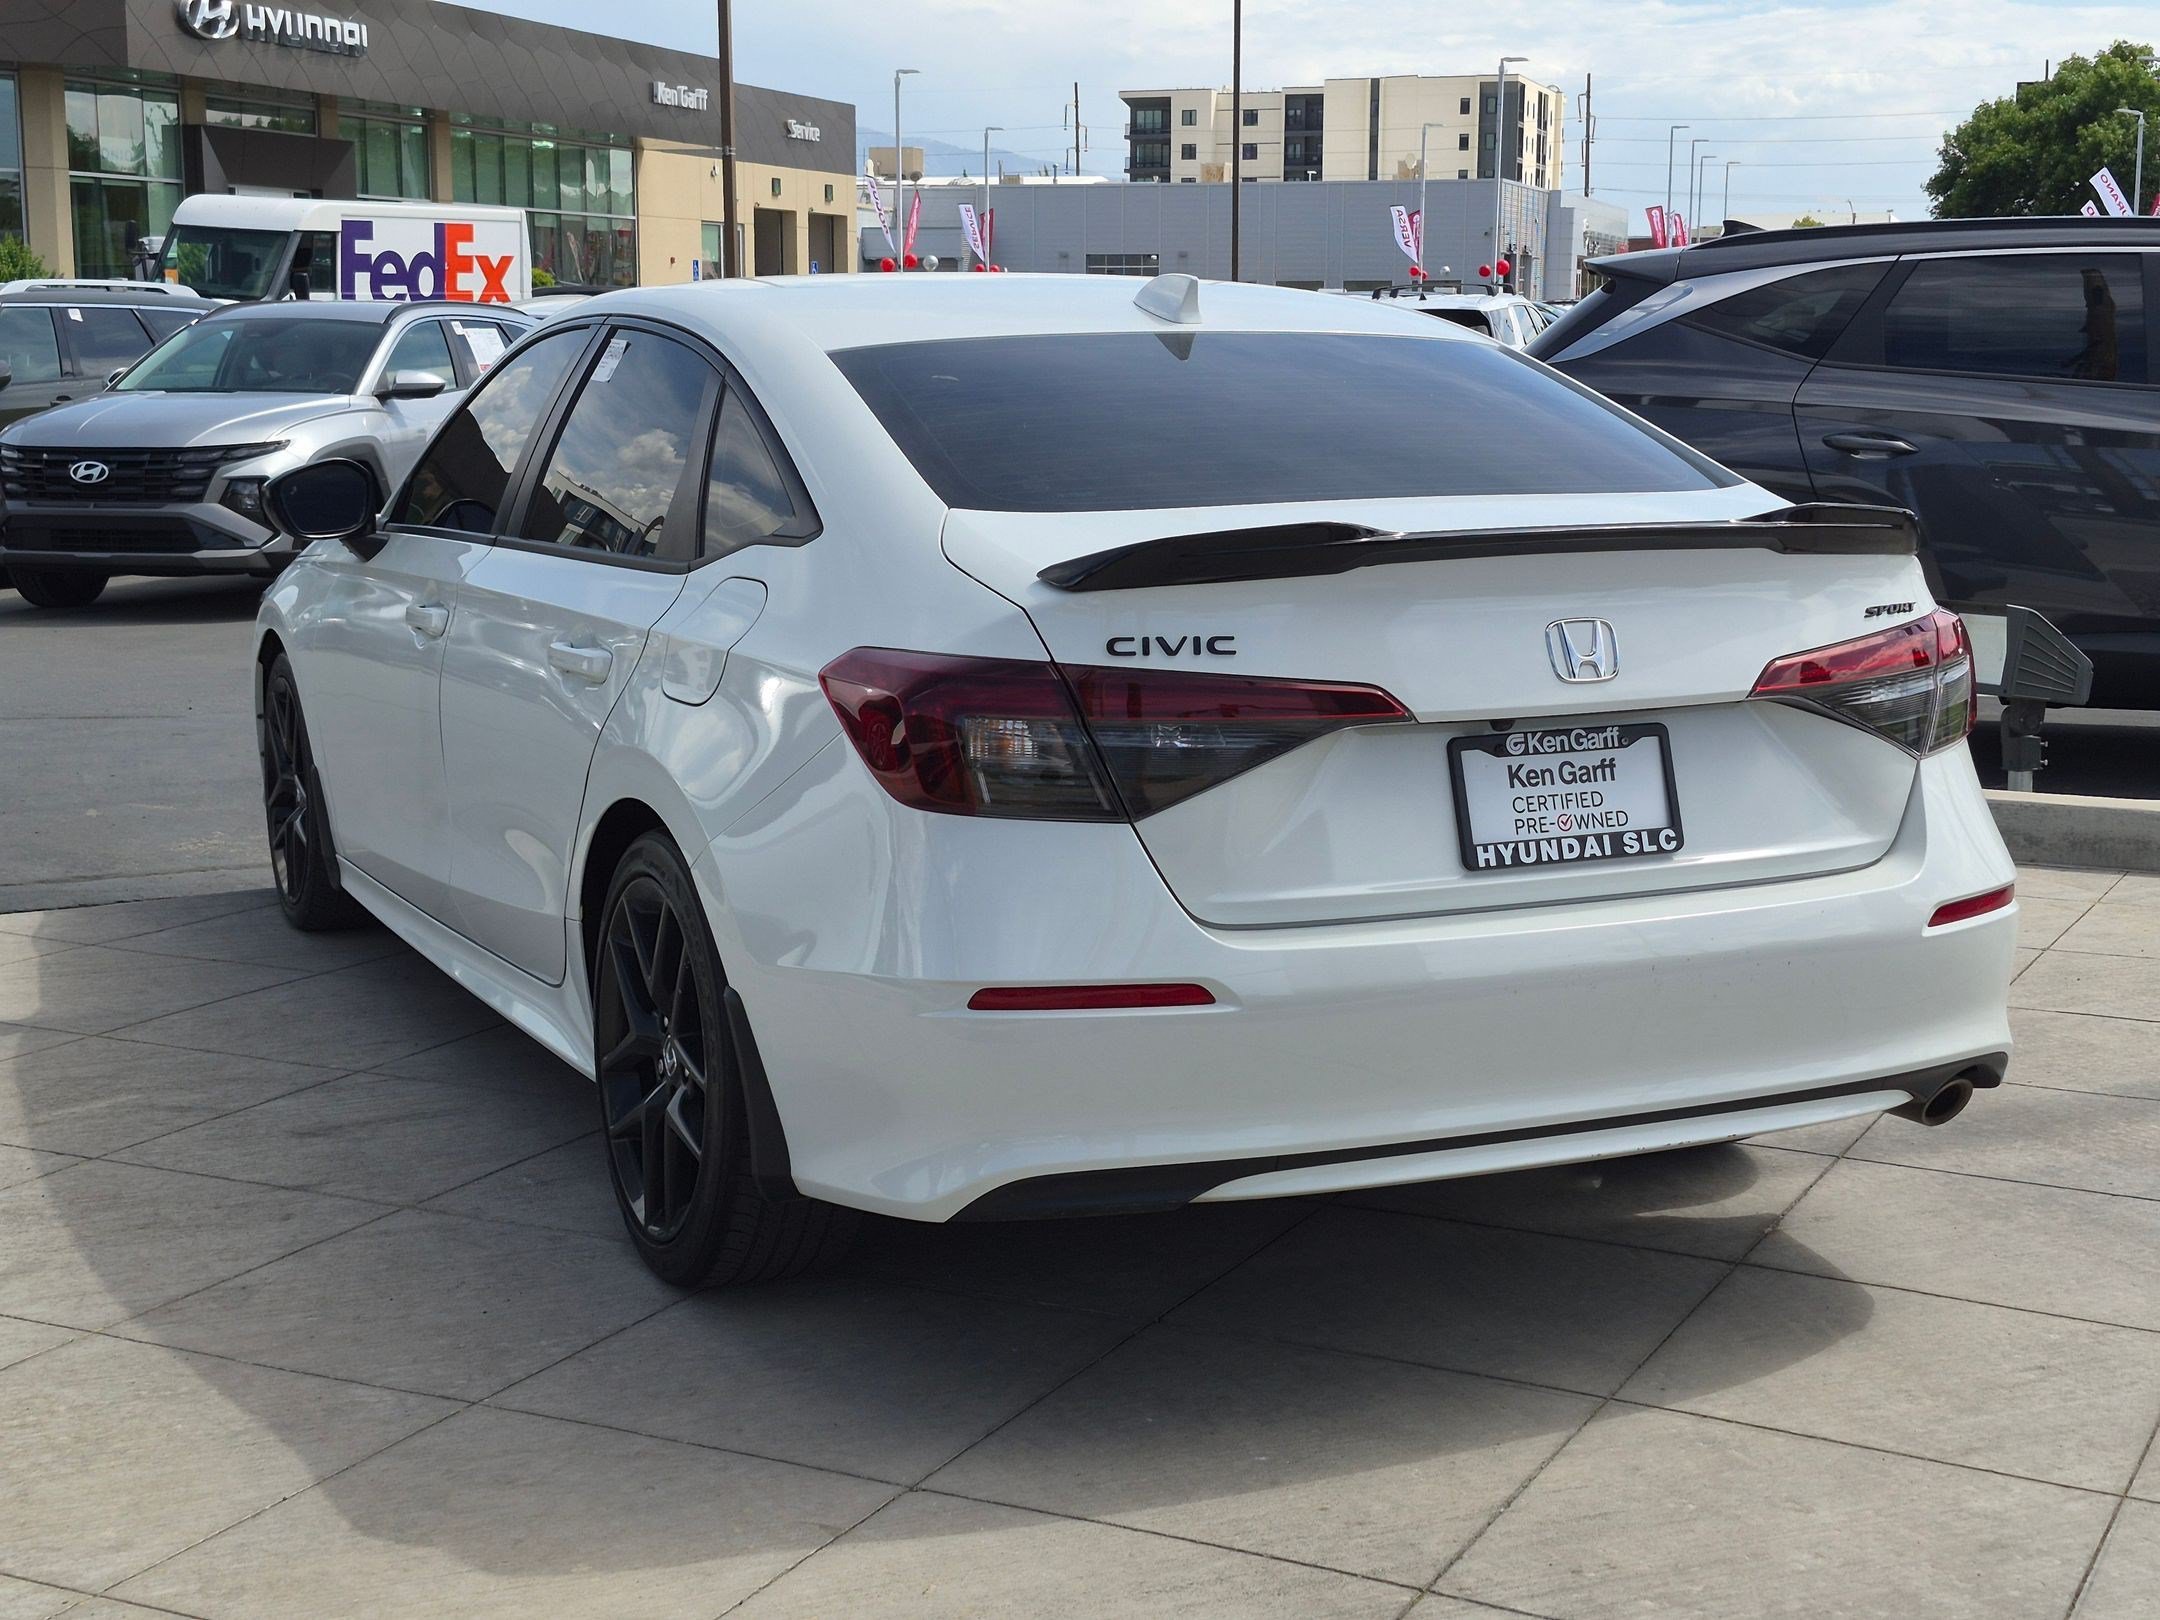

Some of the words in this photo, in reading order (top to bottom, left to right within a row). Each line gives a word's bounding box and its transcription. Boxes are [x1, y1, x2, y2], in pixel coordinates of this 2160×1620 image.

[246, 3, 368, 48] HYUNDAI
[654, 81, 678, 106] Ken
[677, 85, 708, 111] Garff
[787, 119, 821, 142] Service
[341, 219, 515, 303] FedEx
[1864, 602, 1917, 618] SPORT
[1106, 635, 1237, 657] CIVIC
[1527, 732, 1570, 754] Ken
[1570, 726, 1620, 750] Garff
[1507, 763, 1555, 789] Ken
[1558, 757, 1616, 785] Garff
[1512, 790, 1604, 814] CERTIFIED
[1476, 833, 1612, 868] HYUNDAI
[1622, 828, 1678, 855] SLC
